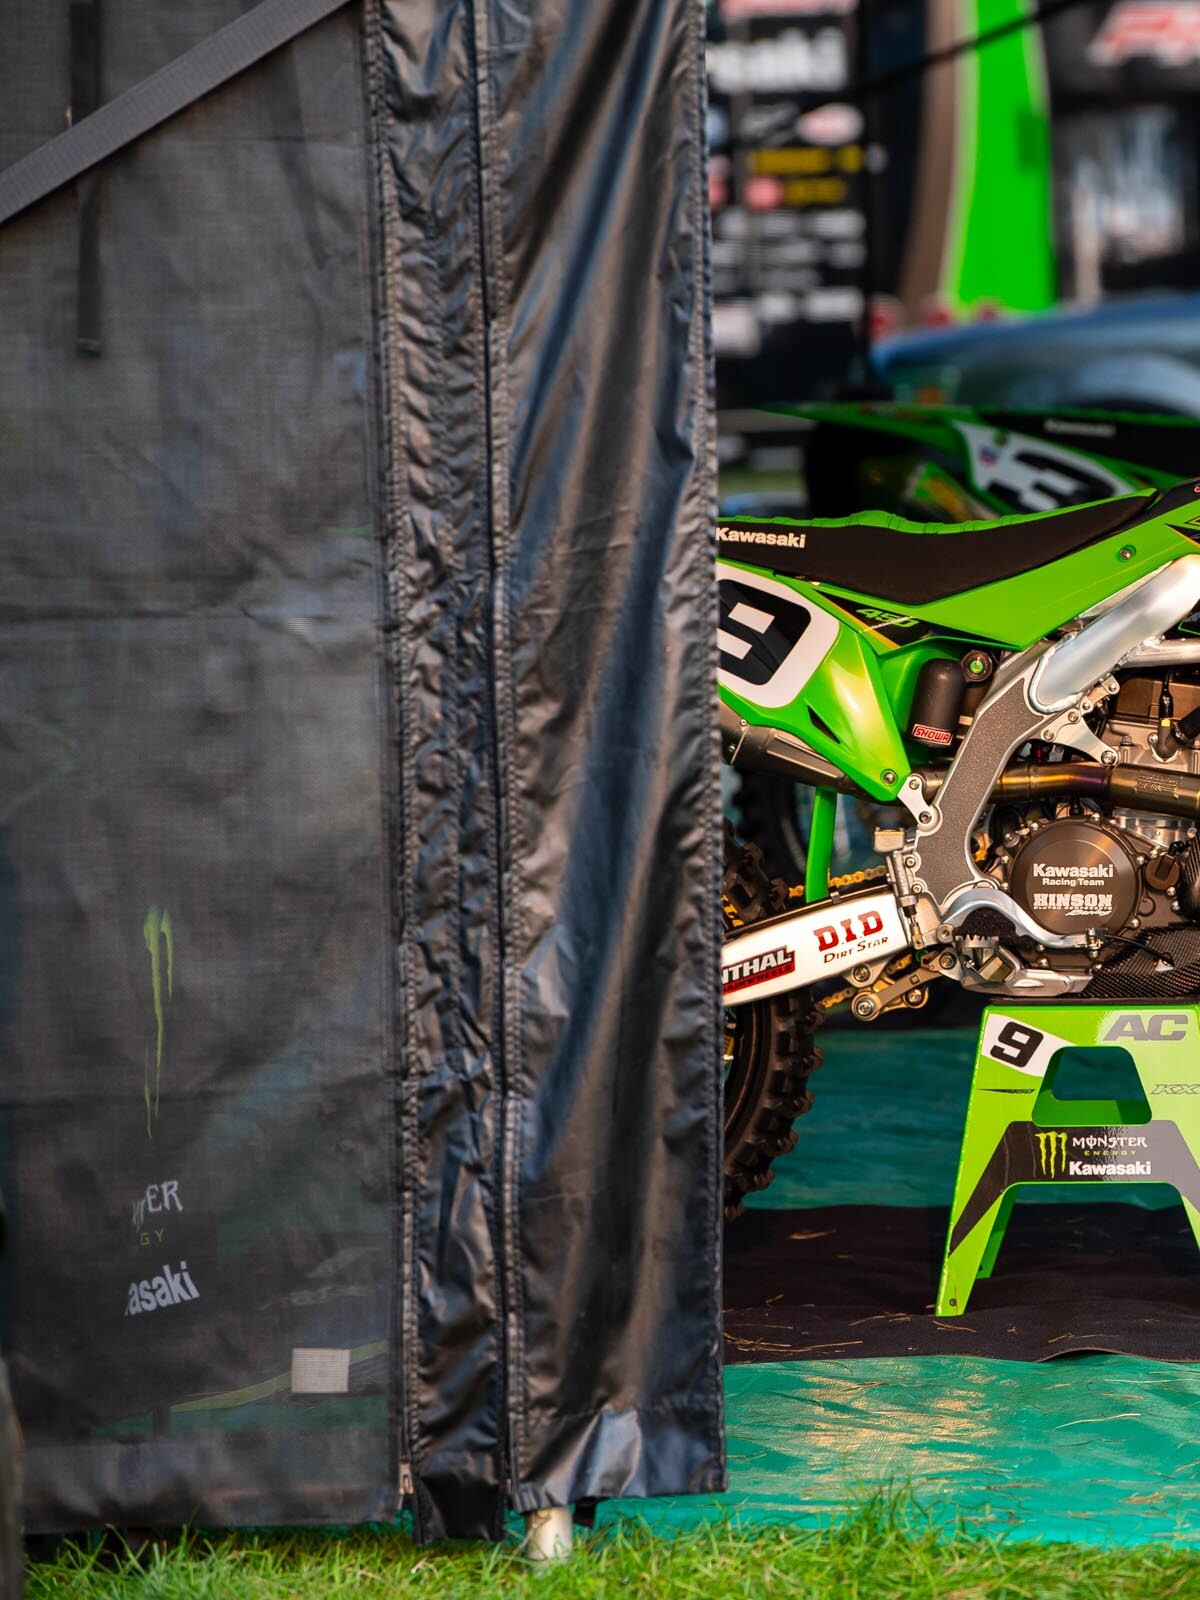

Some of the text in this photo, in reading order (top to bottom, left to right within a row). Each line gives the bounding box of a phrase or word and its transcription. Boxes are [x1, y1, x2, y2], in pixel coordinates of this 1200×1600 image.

[715, 527, 806, 548] Kawasaki
[856, 608, 919, 628] 450
[914, 726, 950, 743] SHOWA
[1033, 863, 1113, 877] Kawasaki
[1042, 878, 1104, 887] Racing Team
[1033, 893, 1113, 907] HINSON
[990, 1015, 1189, 1068] 9 AC
[1072, 1134, 1148, 1148] MONSTER
[1069, 1161, 1151, 1176] Kawasaki
